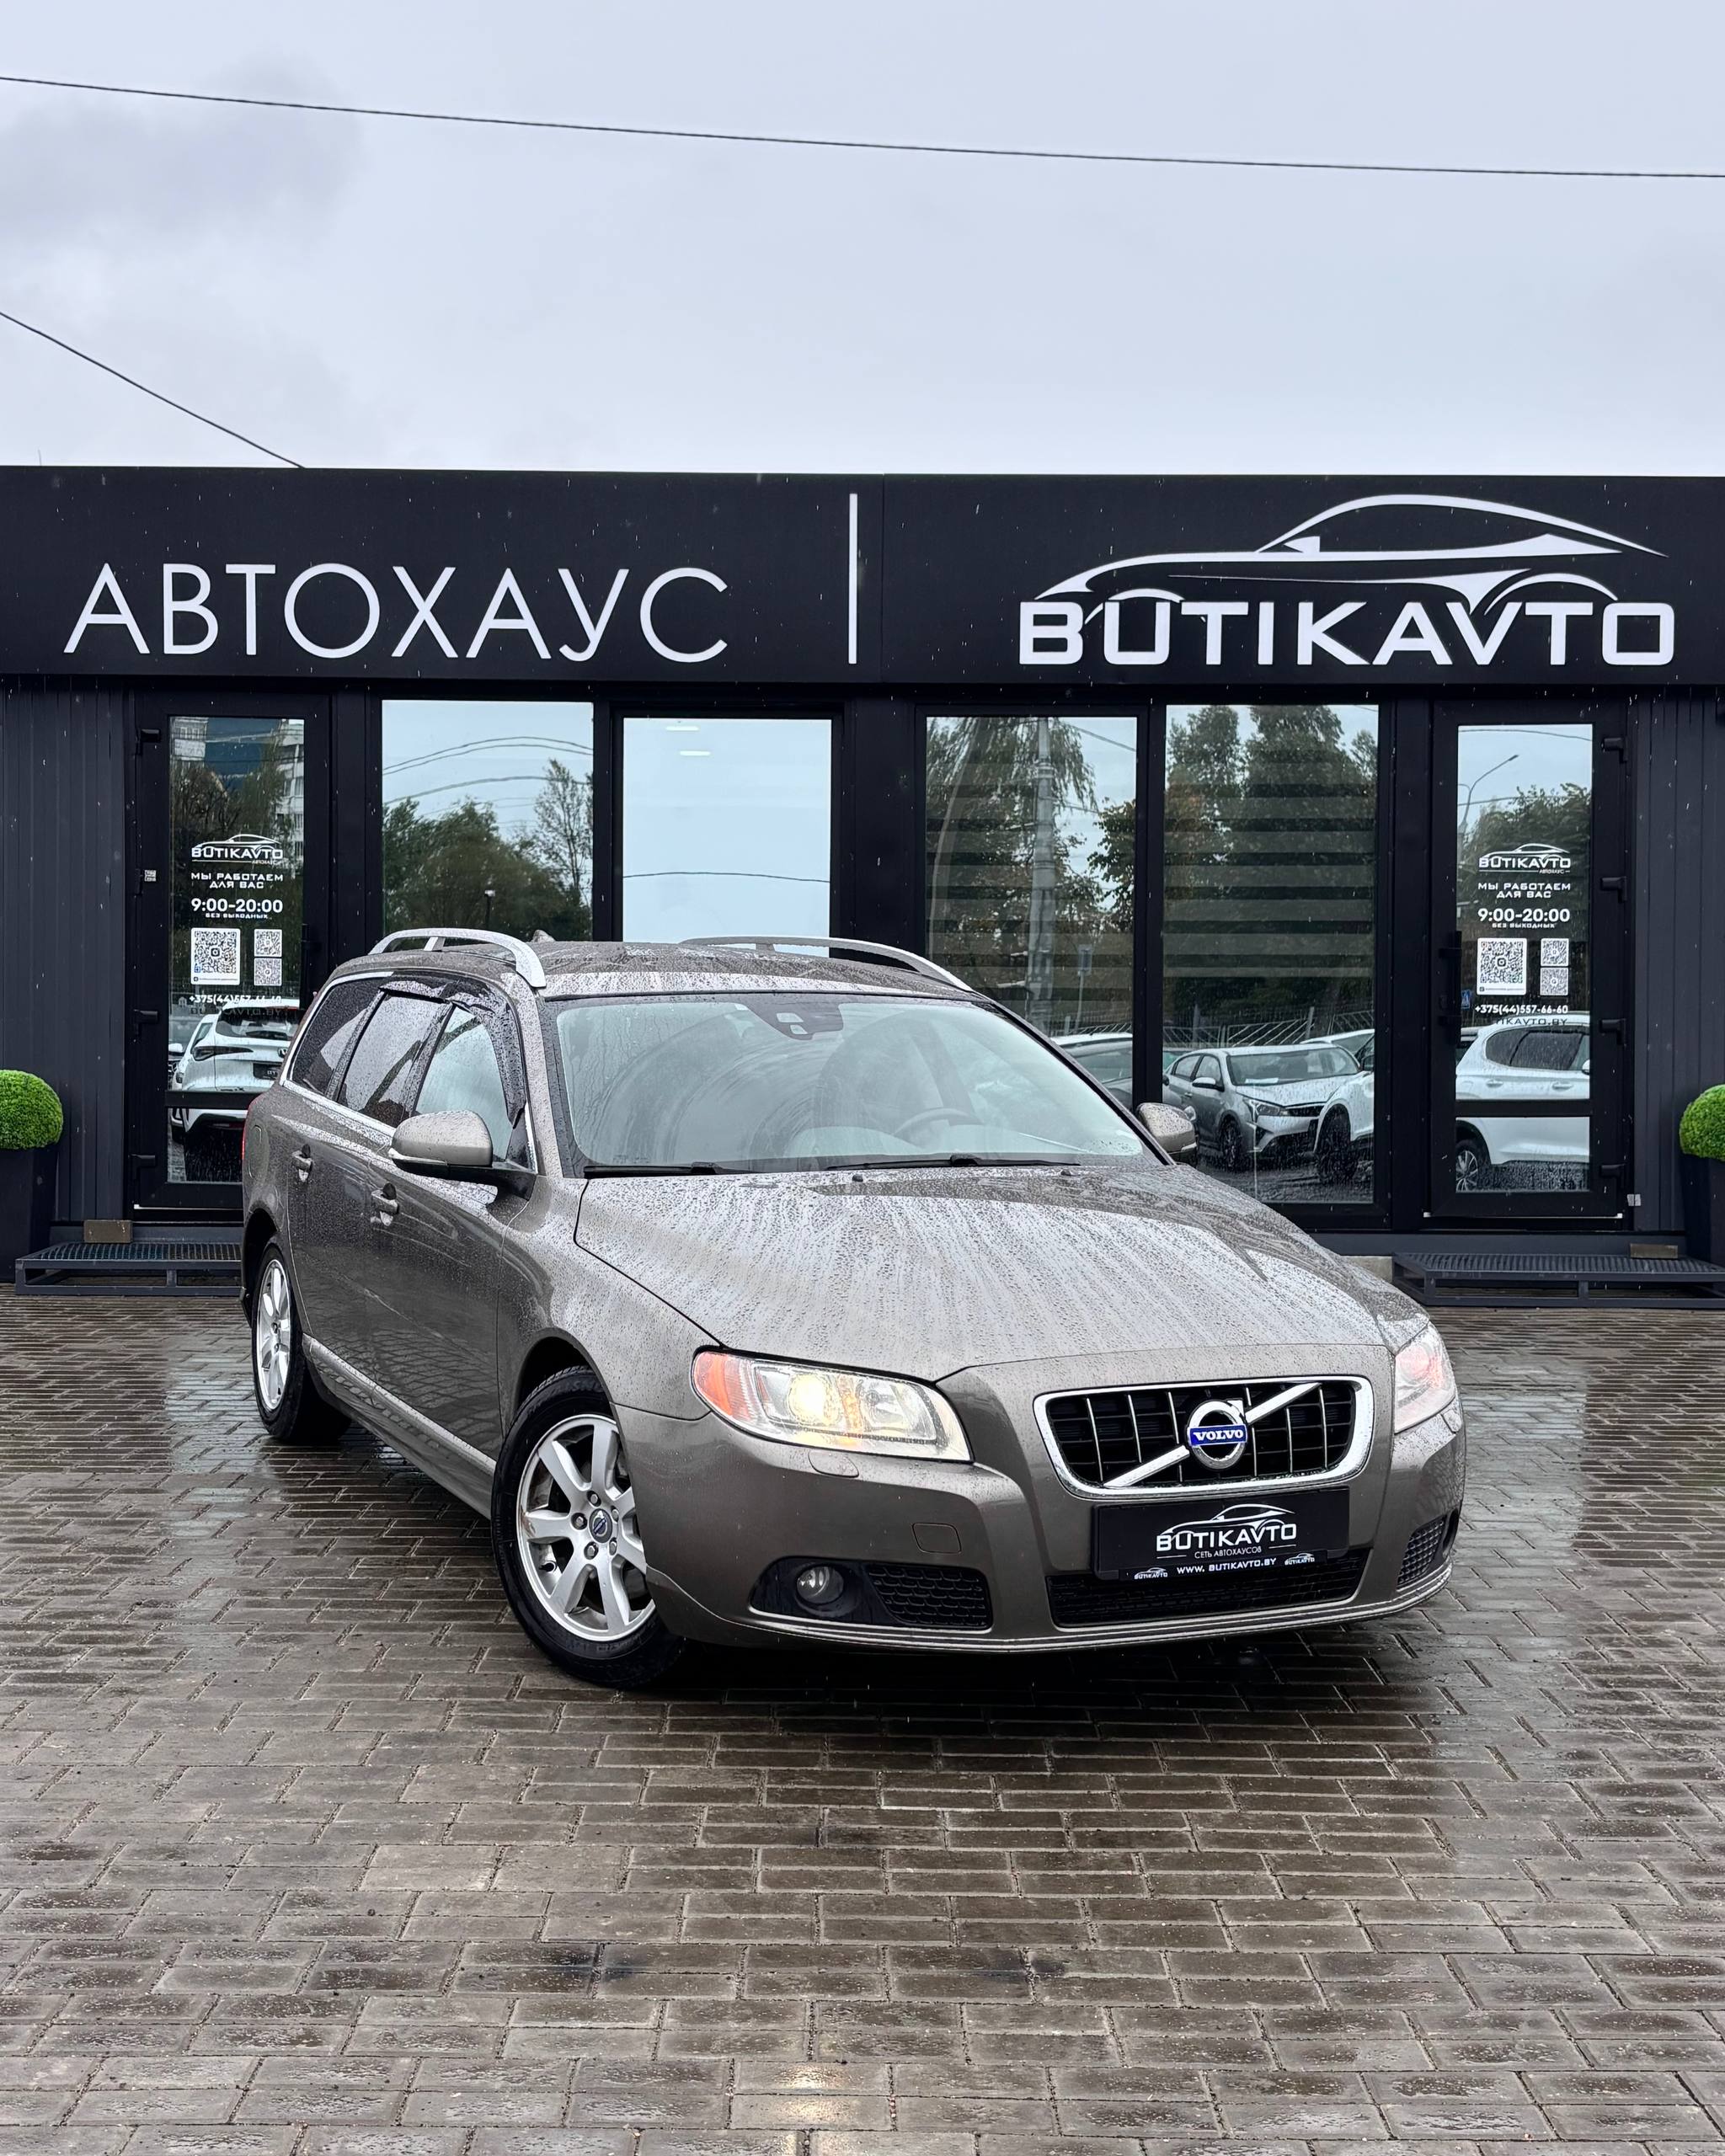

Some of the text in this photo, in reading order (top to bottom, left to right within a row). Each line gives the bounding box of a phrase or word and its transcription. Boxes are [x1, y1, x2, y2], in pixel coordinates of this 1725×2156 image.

[64, 563, 728, 663] АВТОХАУС
[1019, 601, 1674, 665] BUTIKAVTO
[191, 846, 284, 859] BUTIKAVTO
[1478, 857, 1571, 868] BUTIKAVTO
[216, 873, 283, 882] РАБОТАЕМ
[191, 898, 283, 913] 9:00-20:00
[1477, 908, 1570, 922] 9:00-20:00
[1475, 1005, 1568, 1016] +375(44)557-66-60
[1193, 1429, 1244, 1441] VOLVO
[1156, 1524, 1296, 1551] BUTIKAVTO
[1194, 1545, 1262, 1559] СЕТЬ АВТОХАУСОВ
